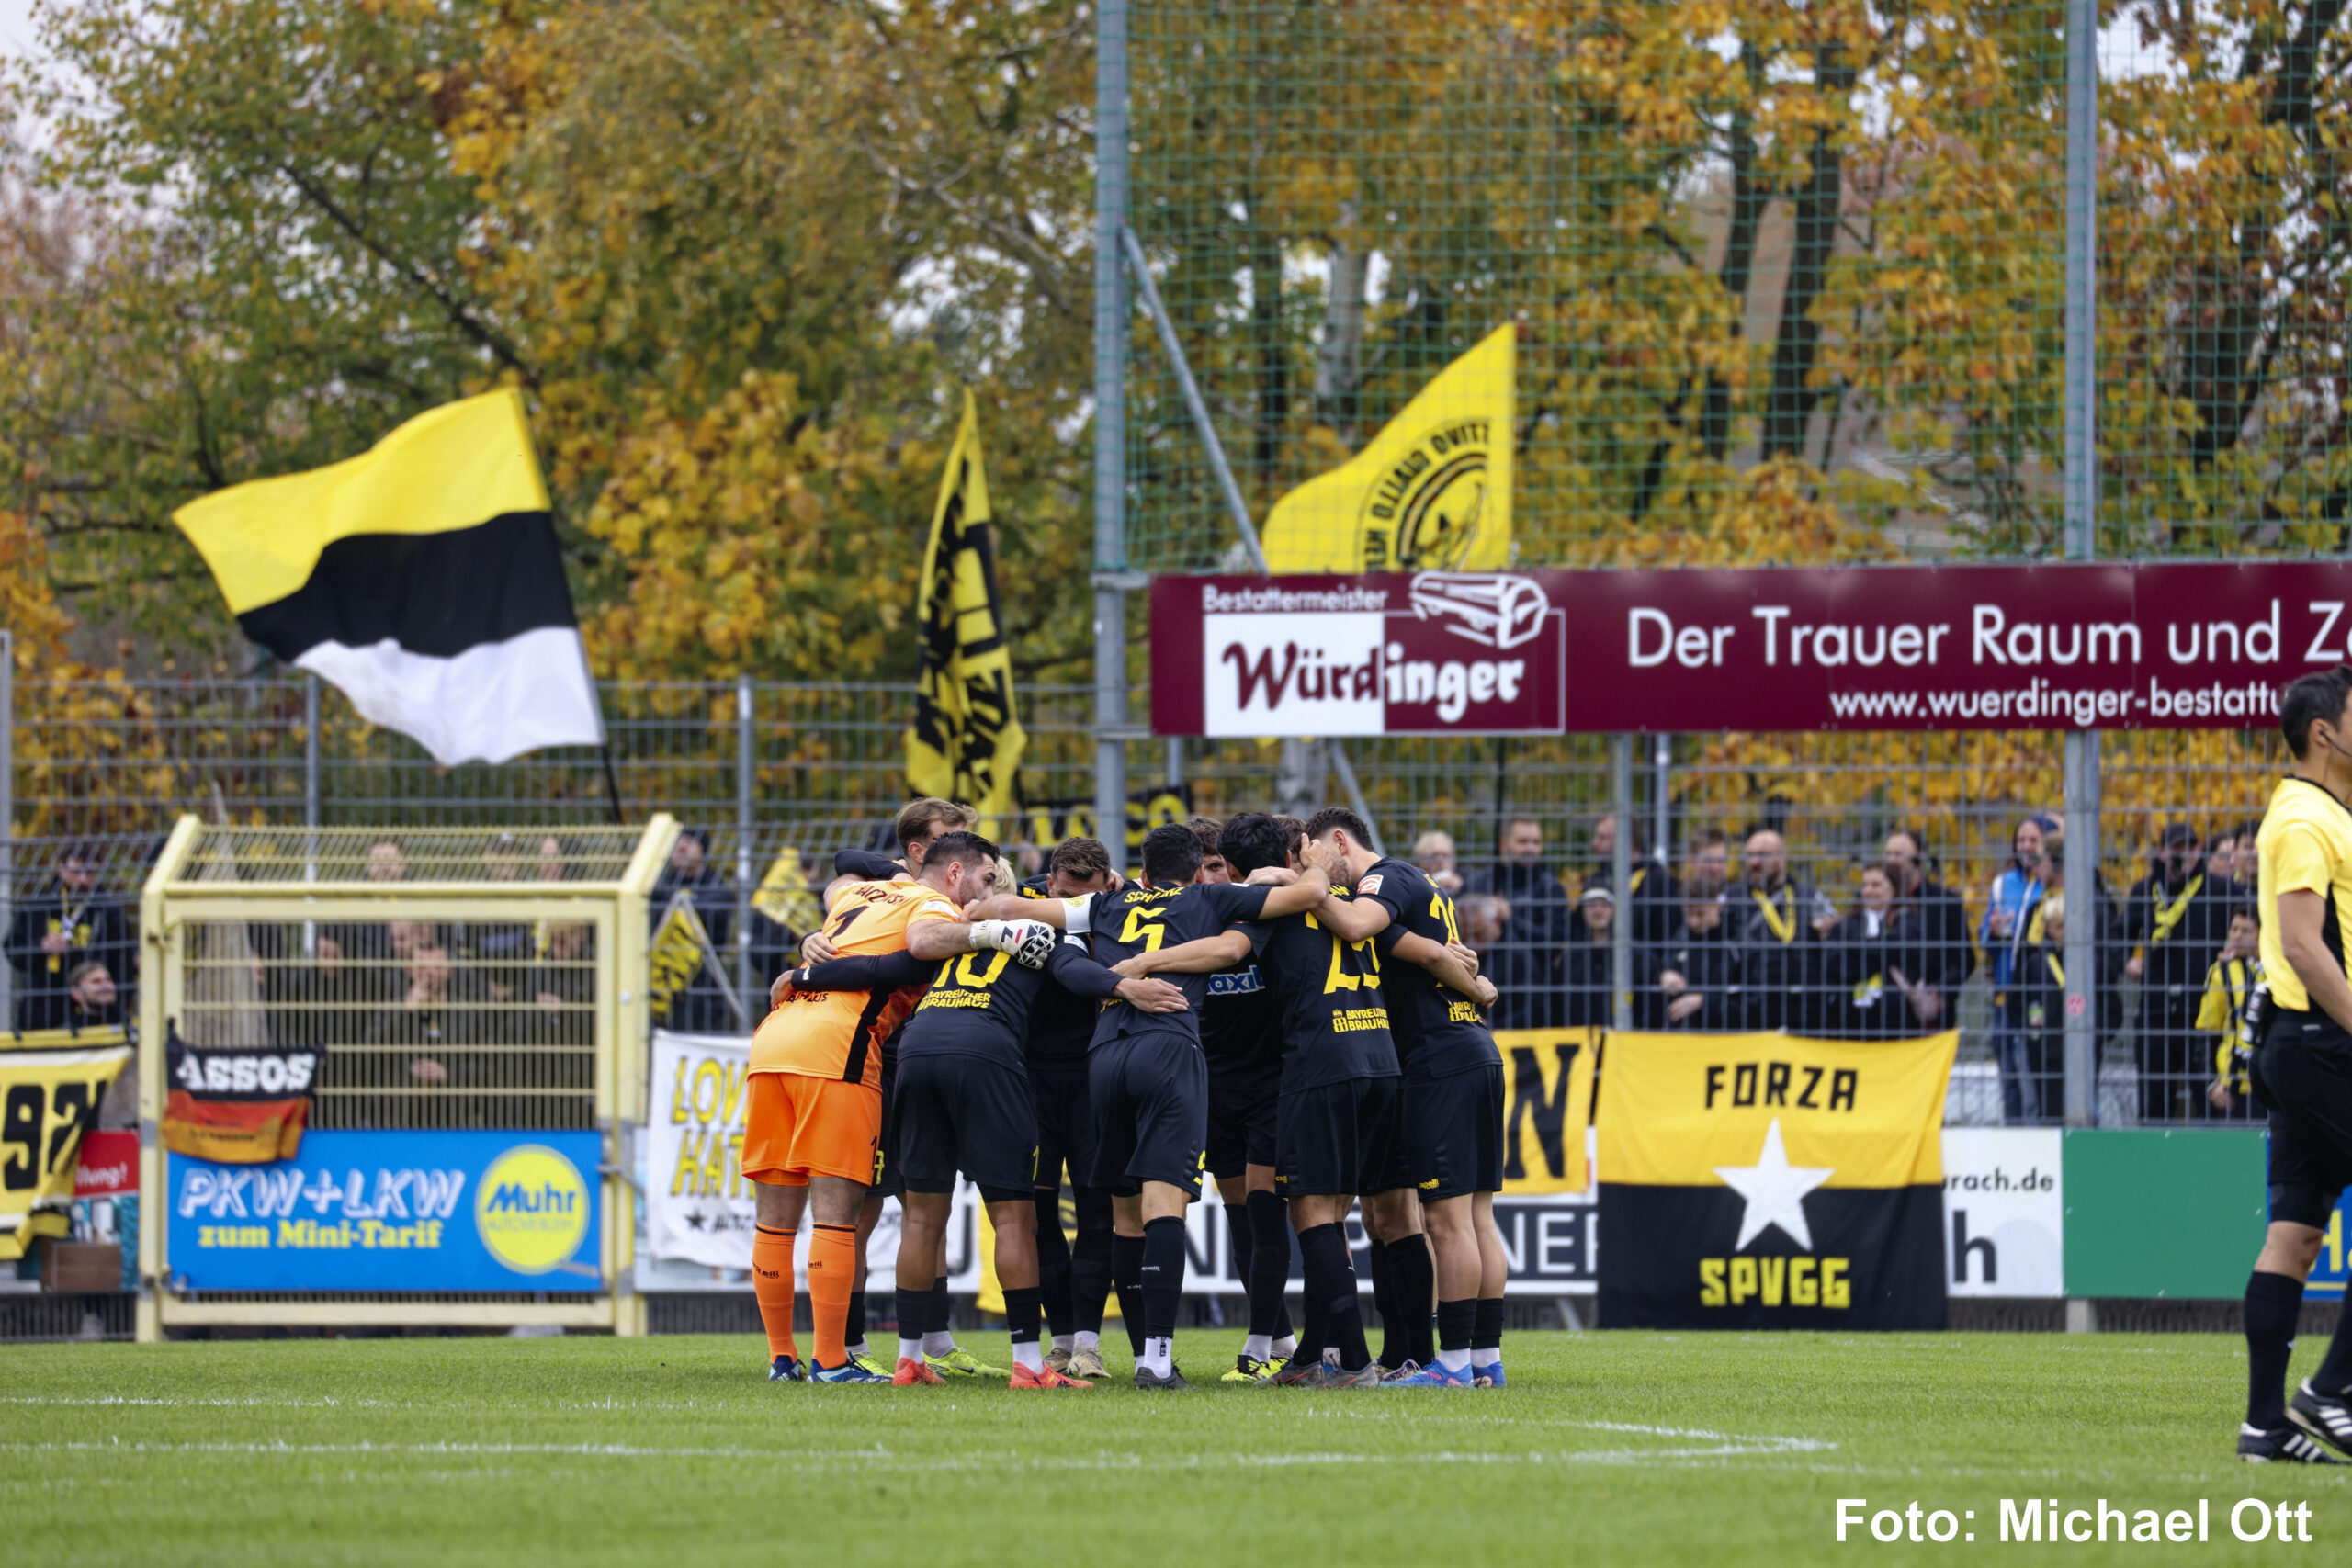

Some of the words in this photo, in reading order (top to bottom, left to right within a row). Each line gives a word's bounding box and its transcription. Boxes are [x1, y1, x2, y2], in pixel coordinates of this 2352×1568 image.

[1203, 585, 1388, 611] Bestattermeister
[1629, 607, 1735, 668] Der
[1752, 606, 1950, 666] Trauer
[1973, 604, 2141, 665] Raum
[2168, 598, 2280, 663] und
[2304, 602, 2352, 661] Z
[1222, 641, 1524, 723] Würdinger
[176, 1048, 315, 1093] ASSOS
[671, 1055, 748, 1126] LOV
[1705, 1061, 1858, 1111] FORZA
[178, 1168, 466, 1218] PKW+LKW
[487, 1182, 576, 1213] Muhr
[198, 1225, 270, 1247] zum
[277, 1219, 443, 1248] Mini-Tarif
[1700, 1256, 1851, 1309] SPVGG
